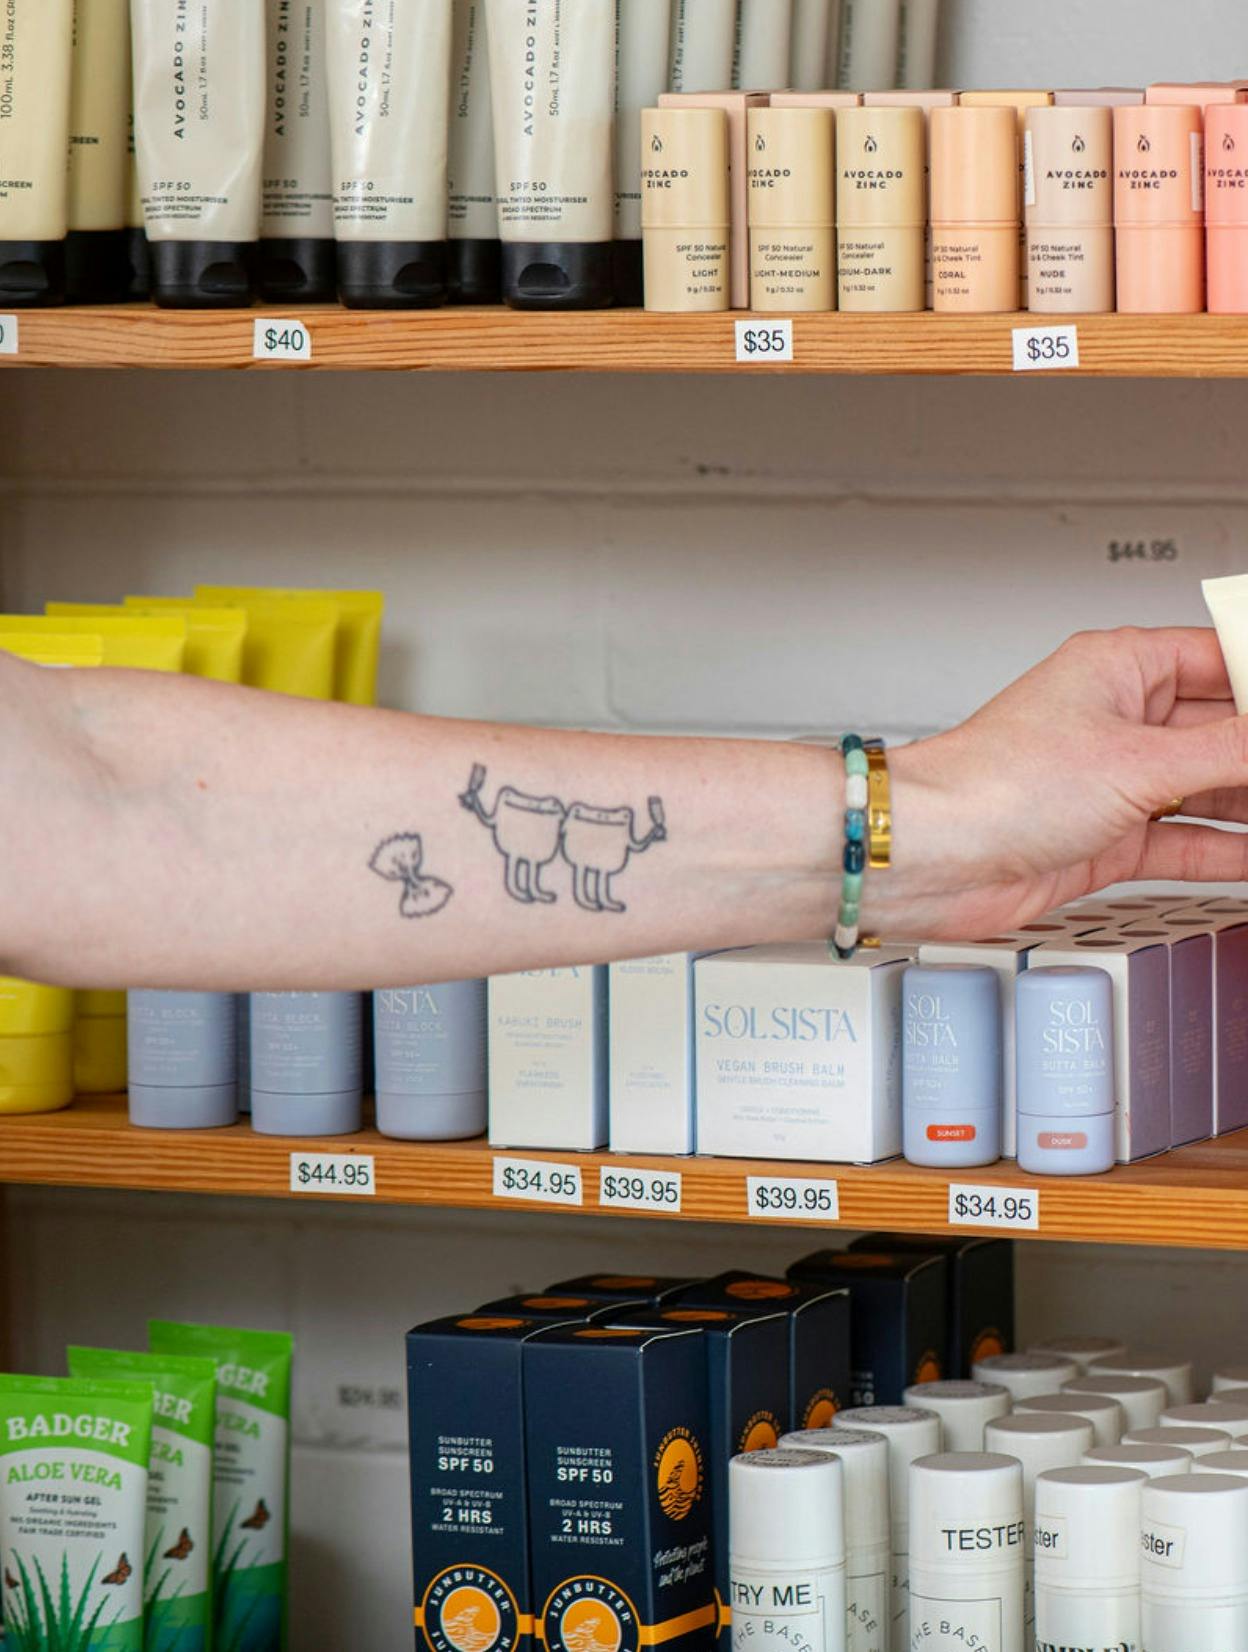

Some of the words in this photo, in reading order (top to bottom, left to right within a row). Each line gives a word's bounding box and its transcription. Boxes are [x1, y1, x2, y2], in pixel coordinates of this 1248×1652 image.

[174, 41, 185, 139] AVOCADO
[275, 41, 287, 136] AVOCADO
[355, 37, 370, 136] AVOCADO
[524, 36, 536, 136] AVOCADO
[844, 170, 903, 179] AVOCADO
[1046, 170, 1107, 179] AVOCADO
[1119, 169, 1178, 179] AVOCADO
[532, 182, 547, 191] 50
[647, 180, 672, 189] ZINC
[751, 179, 774, 188] ZINC
[856, 180, 886, 189] ZINC
[1063, 180, 1094, 189] ZINC
[1130, 180, 1160, 189] ZINC
[1217, 179, 1245, 188] ZINC
[692, 268, 718, 278] LIGHT
[938, 271, 965, 279] CORAL
[1040, 270, 1066, 278] NUDE
[264, 327, 304, 352] $40
[743, 329, 785, 354] $35
[1027, 335, 1071, 361] $35
[908, 993, 950, 1021] SOL
[1048, 999, 1099, 1027] SOL
[905, 1022, 958, 1048] SISTA
[1042, 1027, 1105, 1056] SISTA
[717, 1059, 756, 1073] VEGAN
[764, 1061, 804, 1075] BRUSH
[812, 1063, 845, 1076] BALM
[936, 1128, 966, 1137] SUNSET
[1051, 1137, 1073, 1146] DUSK
[298, 1161, 370, 1186] $44.95
[502, 1166, 577, 1196] $34.95
[603, 1175, 678, 1203] $39.95
[755, 1187, 832, 1213] $39.95
[954, 1193, 1033, 1221] $34.95
[6, 1413, 132, 1447] BADGER
[437, 1434, 493, 1447] SUNBUTTER
[437, 1445, 493, 1457] SUNSCREEN
[556, 1445, 612, 1457] SUNBUTTER
[437, 1457, 470, 1472] SPF
[472, 1458, 494, 1473] 50
[556, 1455, 613, 1468] SUNSCREEN
[7, 1462, 65, 1486] ALOE
[70, 1462, 123, 1491] VERA
[556, 1467, 589, 1483] SPF
[591, 1469, 614, 1484] 50
[26, 1492, 58, 1504] AFTER
[60, 1494, 81, 1505] SUN
[82, 1496, 102, 1507] GEL
[430, 1487, 458, 1496] BROAD
[459, 1488, 504, 1500] SPECTRUM
[549, 1498, 577, 1508] BROAD
[578, 1500, 624, 1511] SPECTRUM
[25, 1517, 62, 1528] ORGANIC
[63, 1519, 118, 1530] INGREDIENTS
[442, 1508, 454, 1522] 2
[457, 1508, 493, 1524] HRS
[37, 1527, 63, 1537] TRADE
[65, 1529, 106, 1540] CERTIFIED
[431, 1523, 457, 1533] WATER
[458, 1525, 505, 1536] RESISTANT
[562, 1519, 572, 1533] 2
[577, 1520, 613, 1535] HRS
[550, 1534, 577, 1545] WATER
[578, 1536, 625, 1546] RESISTANT
[941, 1520, 1025, 1551] TESTER
[1140, 1529, 1174, 1557] ster
[430, 1571, 512, 1612] SUNBUTTER
[731, 1582, 763, 1607] TRY
[772, 1583, 812, 1606] ME
[549, 1582, 632, 1624] SUNBUTTER
